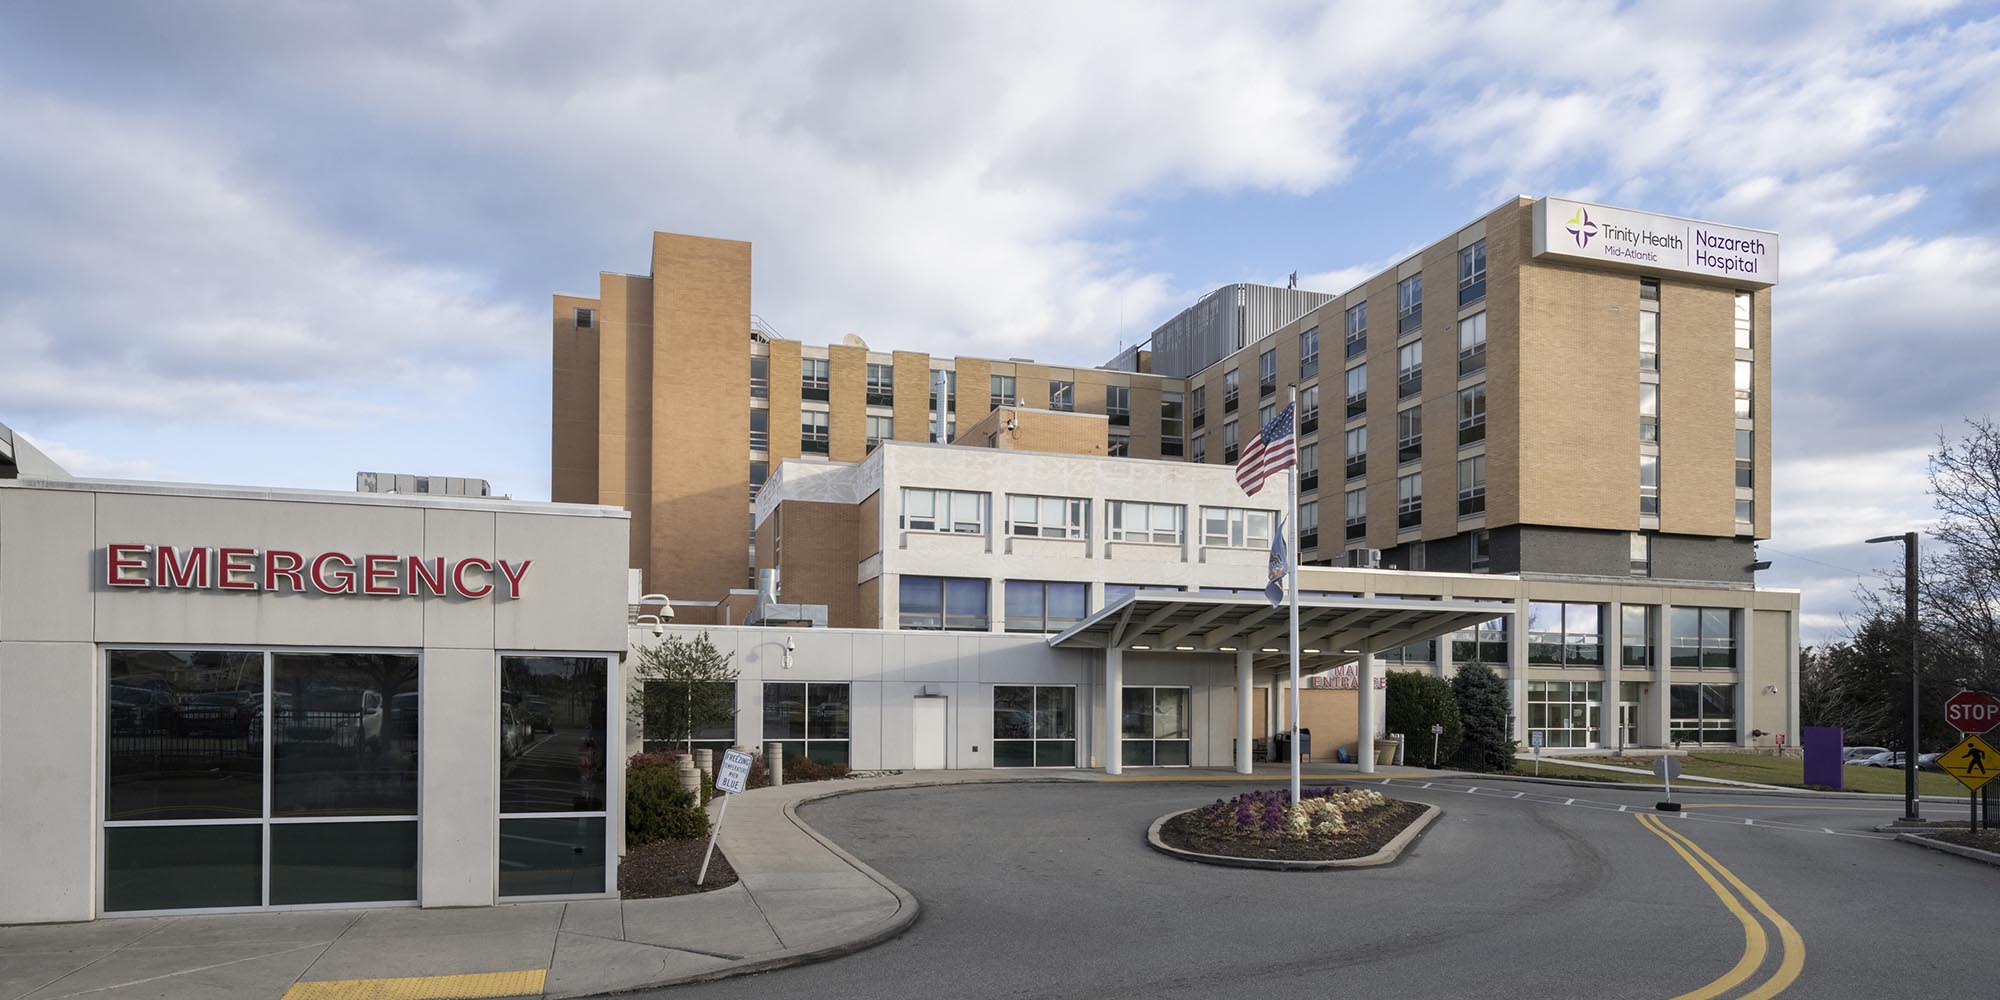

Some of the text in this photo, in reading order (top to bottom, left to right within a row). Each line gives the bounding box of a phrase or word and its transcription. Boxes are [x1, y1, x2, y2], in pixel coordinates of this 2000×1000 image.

[1602, 224, 1683, 250] Trinity Health
[1696, 229, 1765, 255] Nazareth
[1604, 245, 1658, 262] Mid-Atlantic
[1696, 250, 1758, 274] Hospital
[107, 543, 534, 599] EMERGENCY
[1335, 664, 1359, 676] MAI
[1313, 676, 1387, 689] ENTRAE
[1950, 704, 1999, 720] STOP
[722, 777, 740, 789] BLUE
